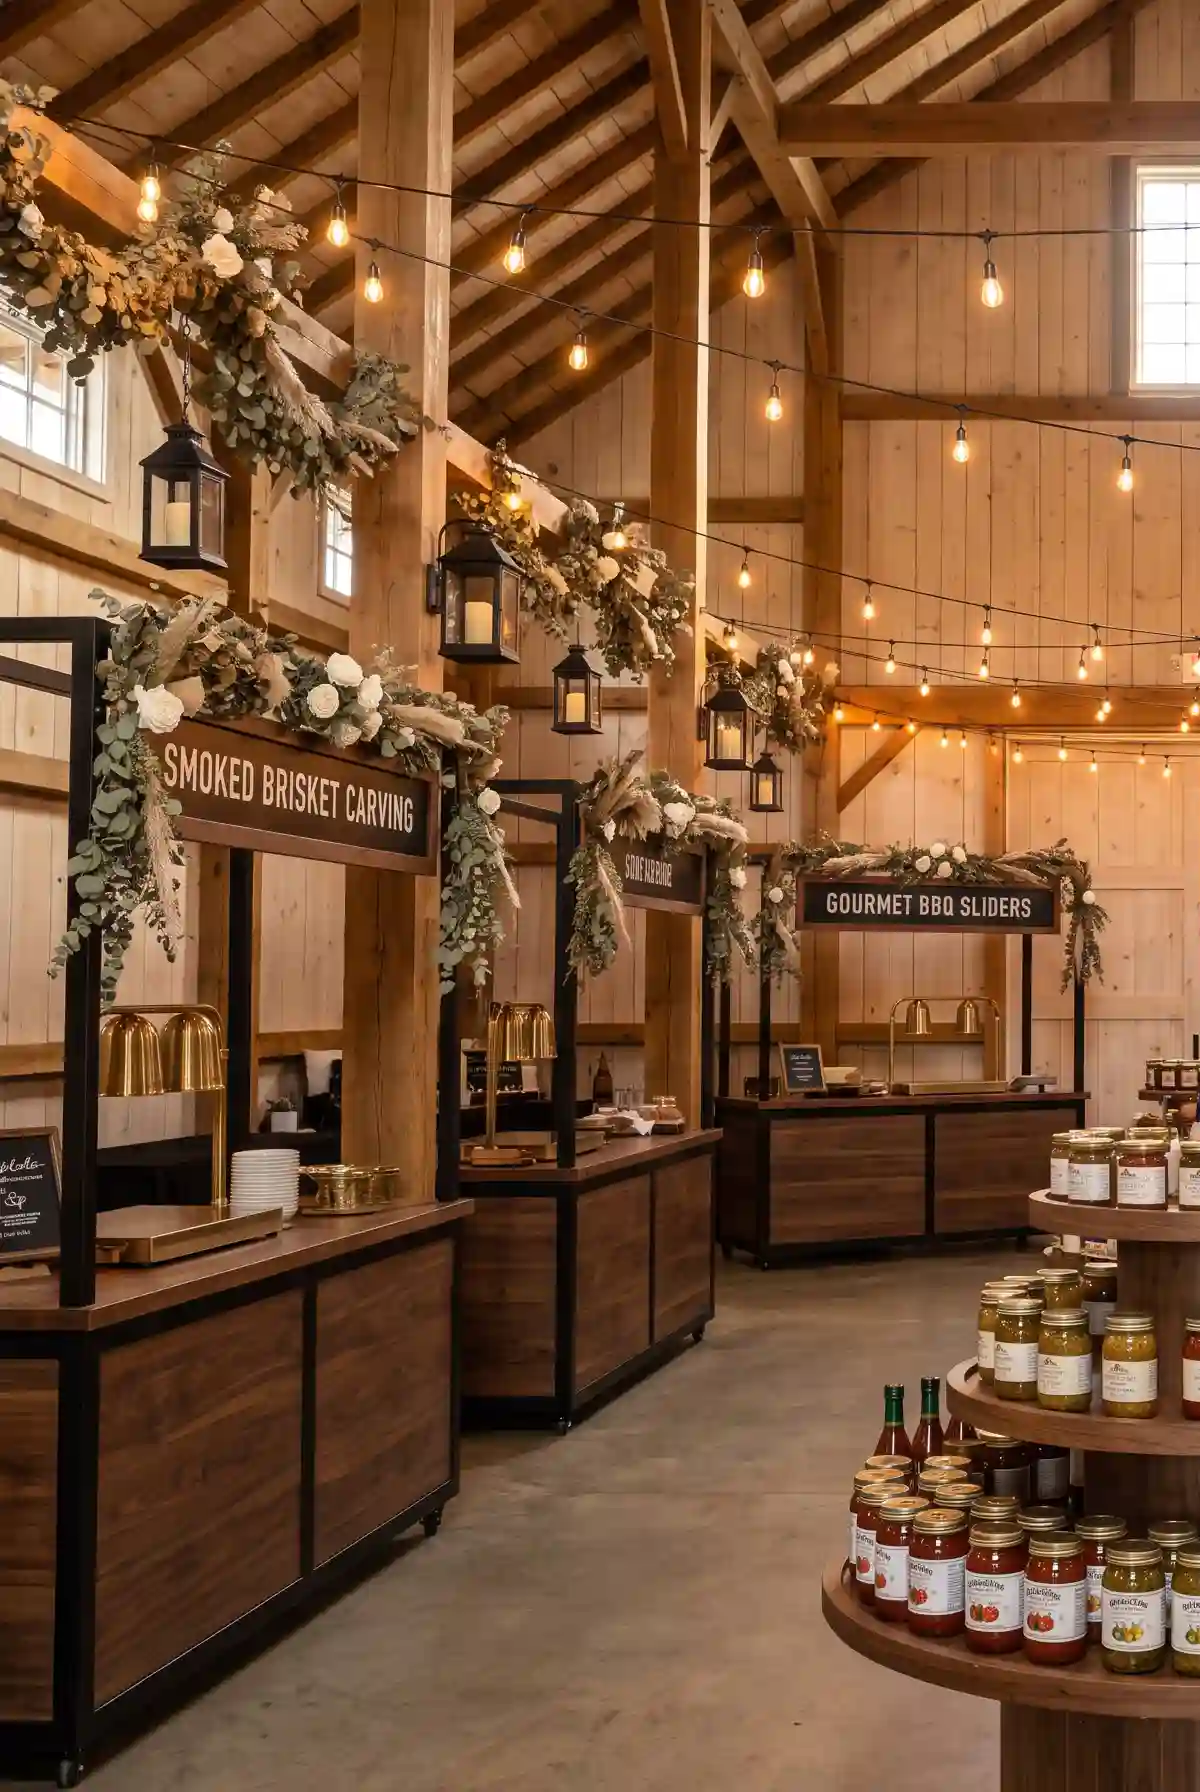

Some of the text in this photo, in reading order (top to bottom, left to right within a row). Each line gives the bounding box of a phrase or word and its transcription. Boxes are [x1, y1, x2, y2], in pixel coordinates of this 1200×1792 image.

[163, 742, 413, 834] SMOKED BRISKET CARVING
[826, 892, 1031, 918] GOURMET BBQ SLIDERS
